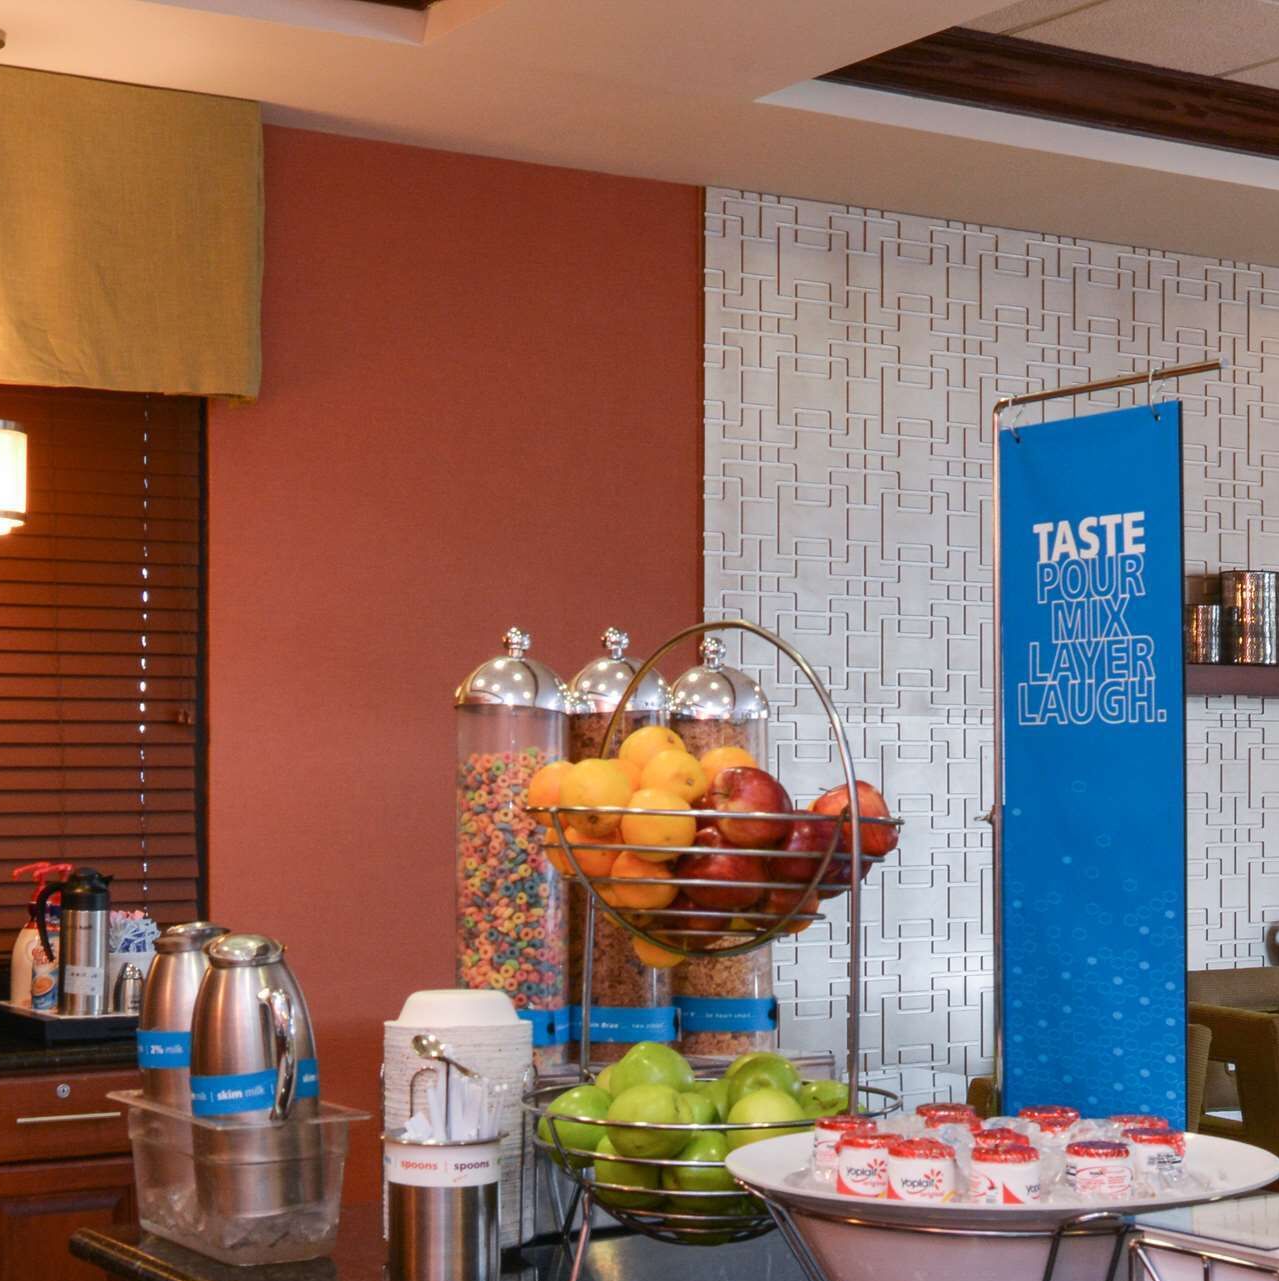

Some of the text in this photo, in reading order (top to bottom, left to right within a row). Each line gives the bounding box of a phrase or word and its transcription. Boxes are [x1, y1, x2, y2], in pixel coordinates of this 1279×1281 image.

[1032, 511, 1146, 563] TASTE
[1037, 552, 1146, 604] POUR
[1051, 594, 1131, 644] MIX
[1029, 635, 1156, 685] LAYER
[1018, 677, 1168, 726] LAUGH.
[217, 1089, 244, 1101] skim
[244, 1084, 265, 1098] milk
[401, 1160, 438, 1171] spoons
[454, 1159, 490, 1172] spoons
